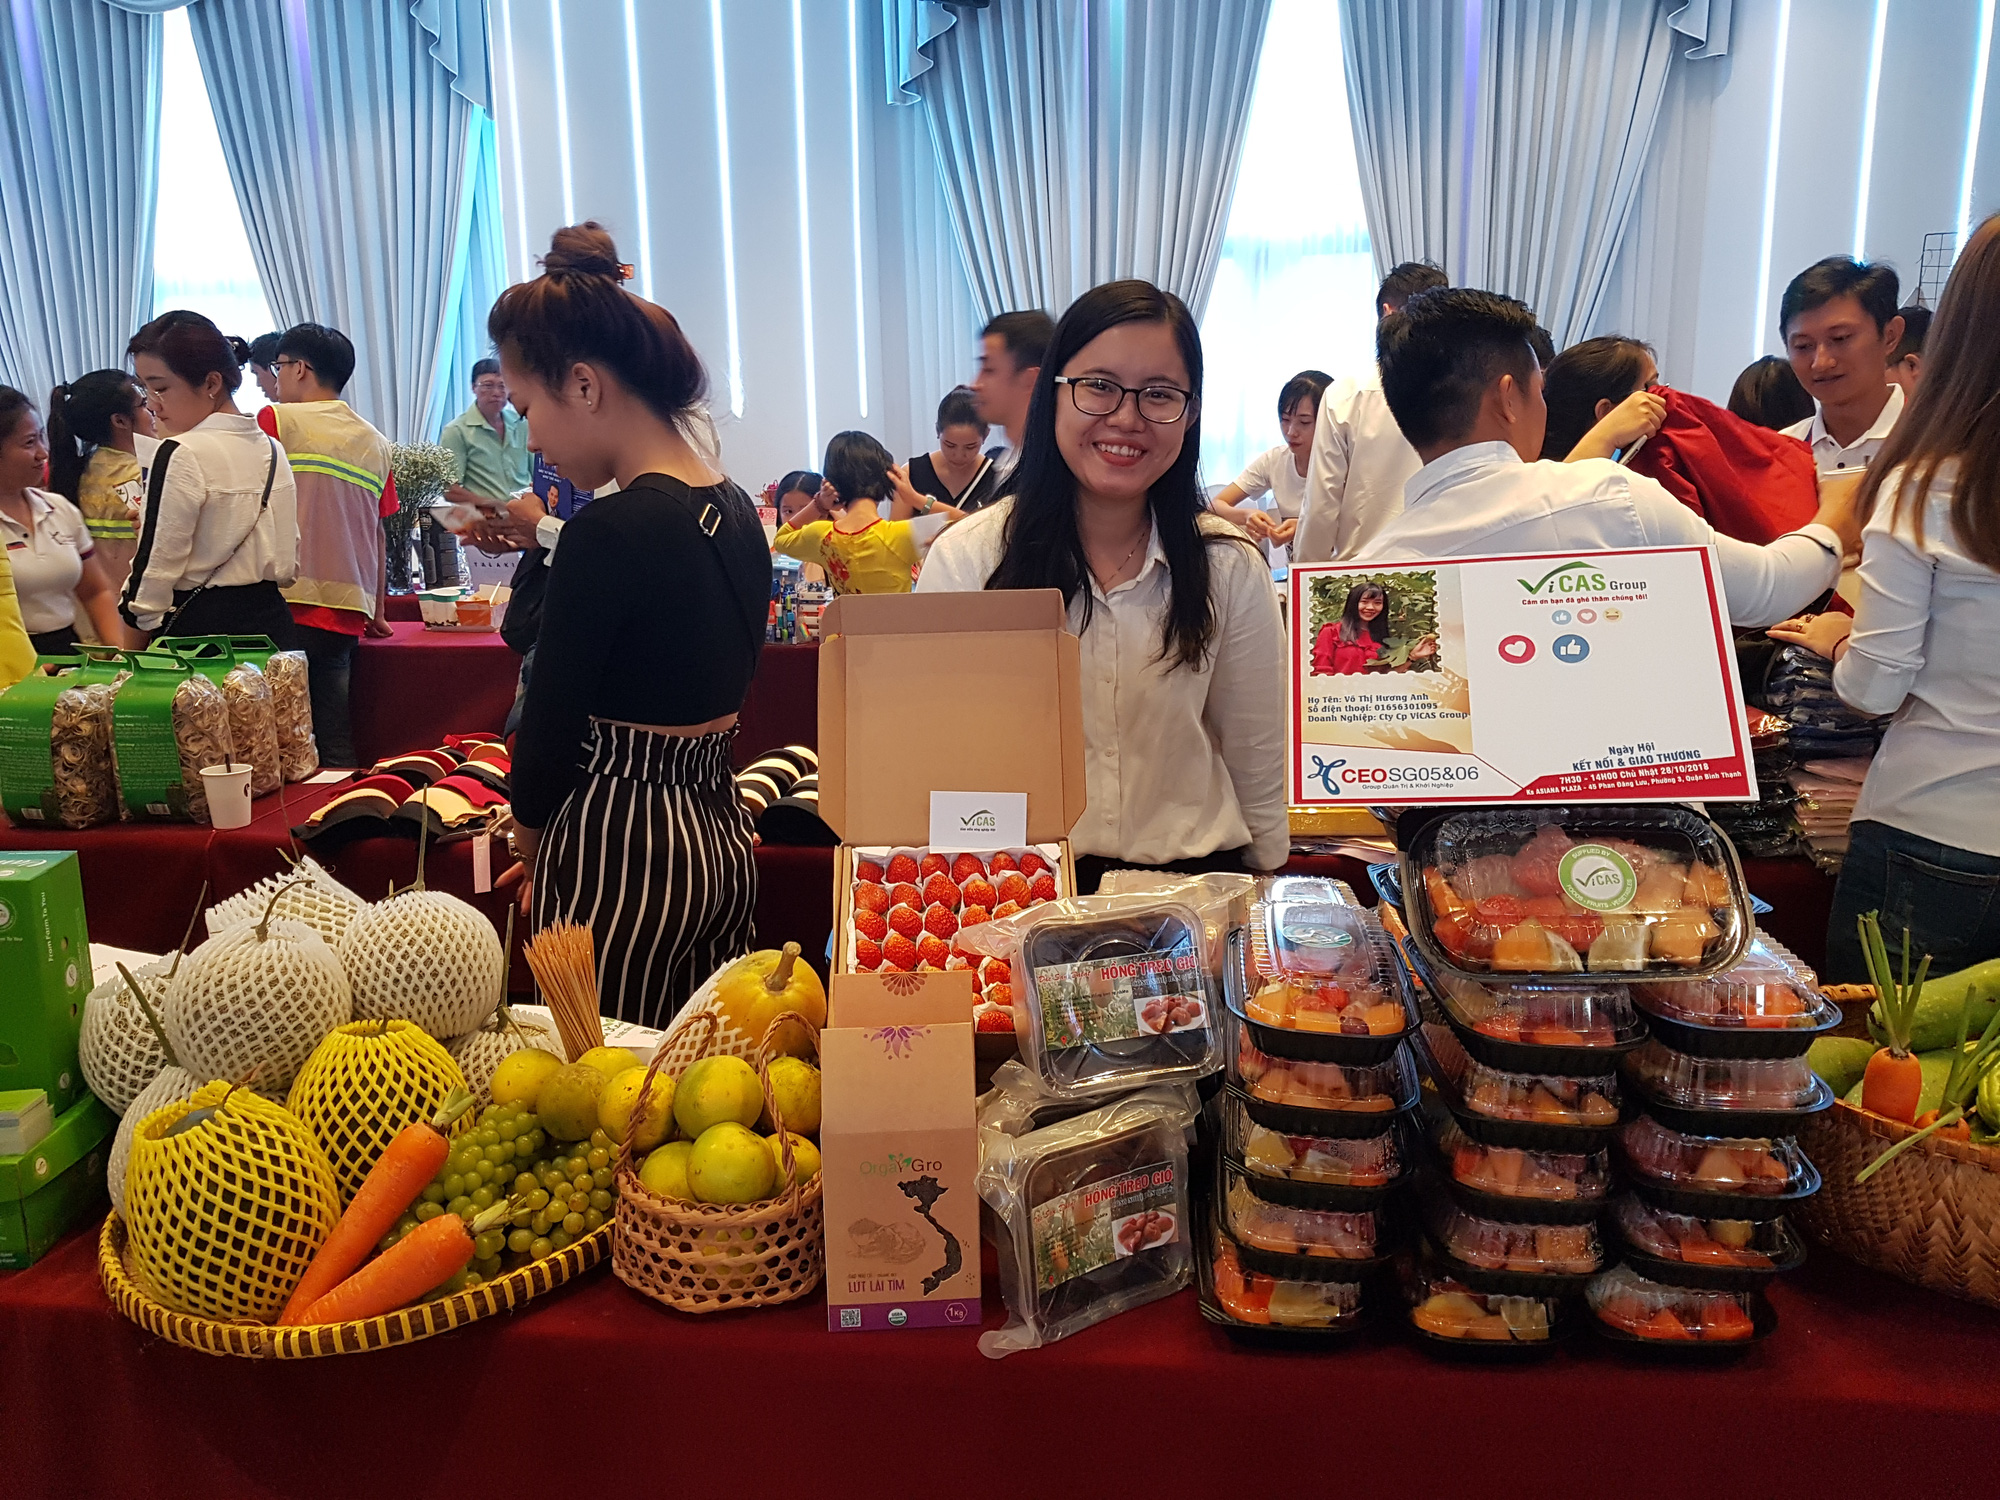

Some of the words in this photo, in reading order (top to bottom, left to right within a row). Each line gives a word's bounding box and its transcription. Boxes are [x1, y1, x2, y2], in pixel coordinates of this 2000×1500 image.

[1517, 562, 1606, 594] ViCAS
[1610, 581, 1646, 591] Group
[1577, 597, 1589, 605] ghé
[1308, 696, 1319, 705] Họ
[1359, 695, 1373, 703] Thị
[1376, 694, 1407, 703] Hương
[1308, 704, 1318, 713] Số
[1321, 705, 1342, 713] điện
[1345, 704, 1371, 713] thoại:
[1374, 703, 1438, 711] 01656301095
[1308, 714, 1337, 722] Doanh
[1340, 714, 1376, 722] Nghiệp:
[1379, 713, 1393, 722] Cty
[1396, 713, 1407, 721] Cp
[1439, 711, 1468, 719] Group
[1608, 745, 1634, 756] Ngày
[1638, 742, 1655, 753] Hội
[1572, 758, 1592, 771] KẾT
[1595, 756, 1613, 769] NỐI
[1618, 758, 1625, 766] &
[1629, 755, 1654, 765] GIAO
[1656, 750, 1701, 762] THƯƠNG
[1560, 775, 1582, 785] 7H30
[1590, 772, 1618, 781] 14H00
[1620, 769, 1636, 778] Chủ
[1638, 768, 1658, 777] Nhật
[1661, 763, 1709, 775] 28/10/2018
[1616, 780, 1634, 788] Đăng
[1651, 776, 1676, 784] Phường
[1686, 775, 1703, 783] Quận
[1704, 772, 1720, 780] Bình
[1721, 771, 1742, 779] Thạnh
[1572, 848, 1600, 859] SUPPLIED
[1576, 867, 1620, 887] ViCAS
[1567, 884, 1583, 900] FOODS
[1587, 900, 1609, 908] FRUITS
[43, 908, 48, 917] To
[1101, 960, 1136, 981] HỒNG
[1139, 958, 1172, 975] TREO
[1085, 1186, 1116, 1208] HỒNG
[1118, 1174, 1149, 1195] TREO
